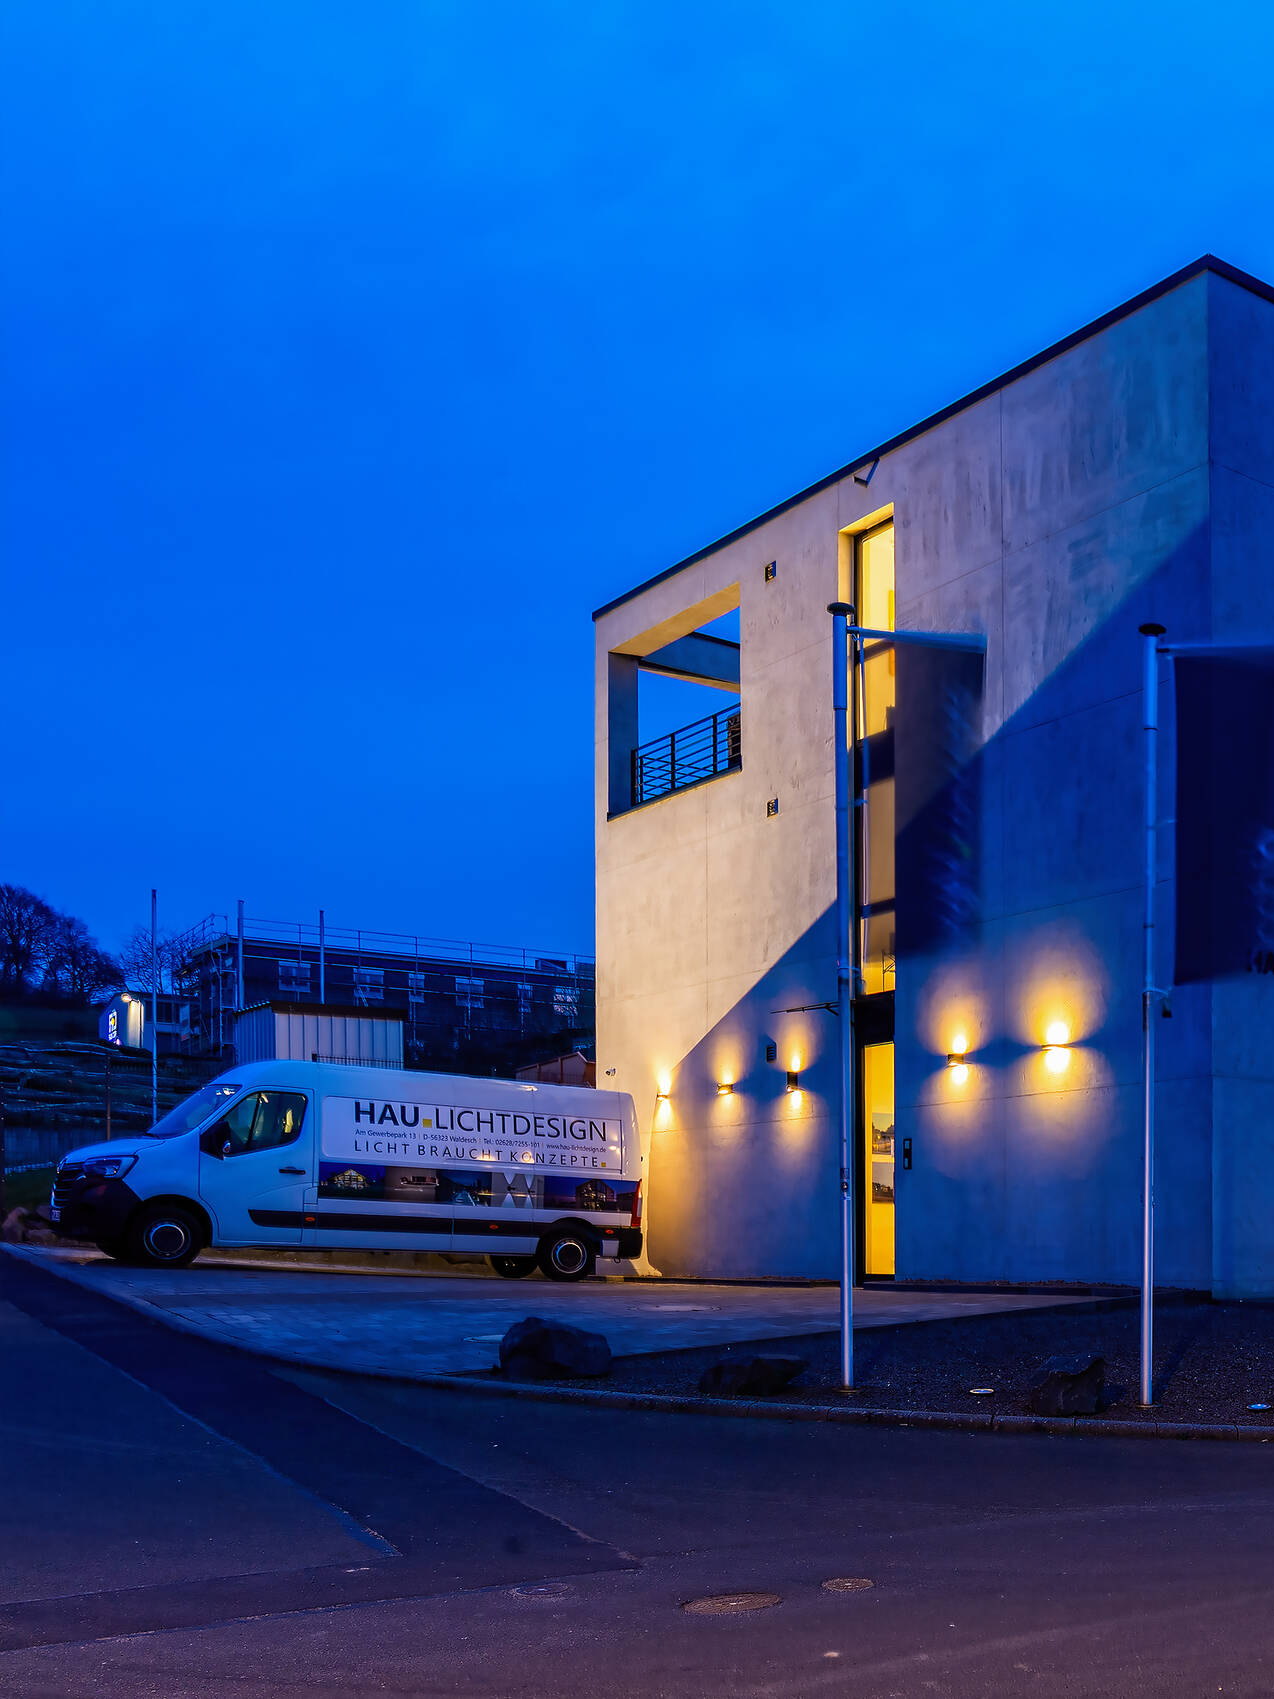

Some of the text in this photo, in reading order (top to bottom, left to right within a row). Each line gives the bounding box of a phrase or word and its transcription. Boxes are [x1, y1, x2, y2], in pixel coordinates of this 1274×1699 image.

[367, 1130, 408, 1139] Gewerbepark
[354, 1140, 409, 1154] LICHT
[418, 1145, 502, 1160] BRAUCHT
